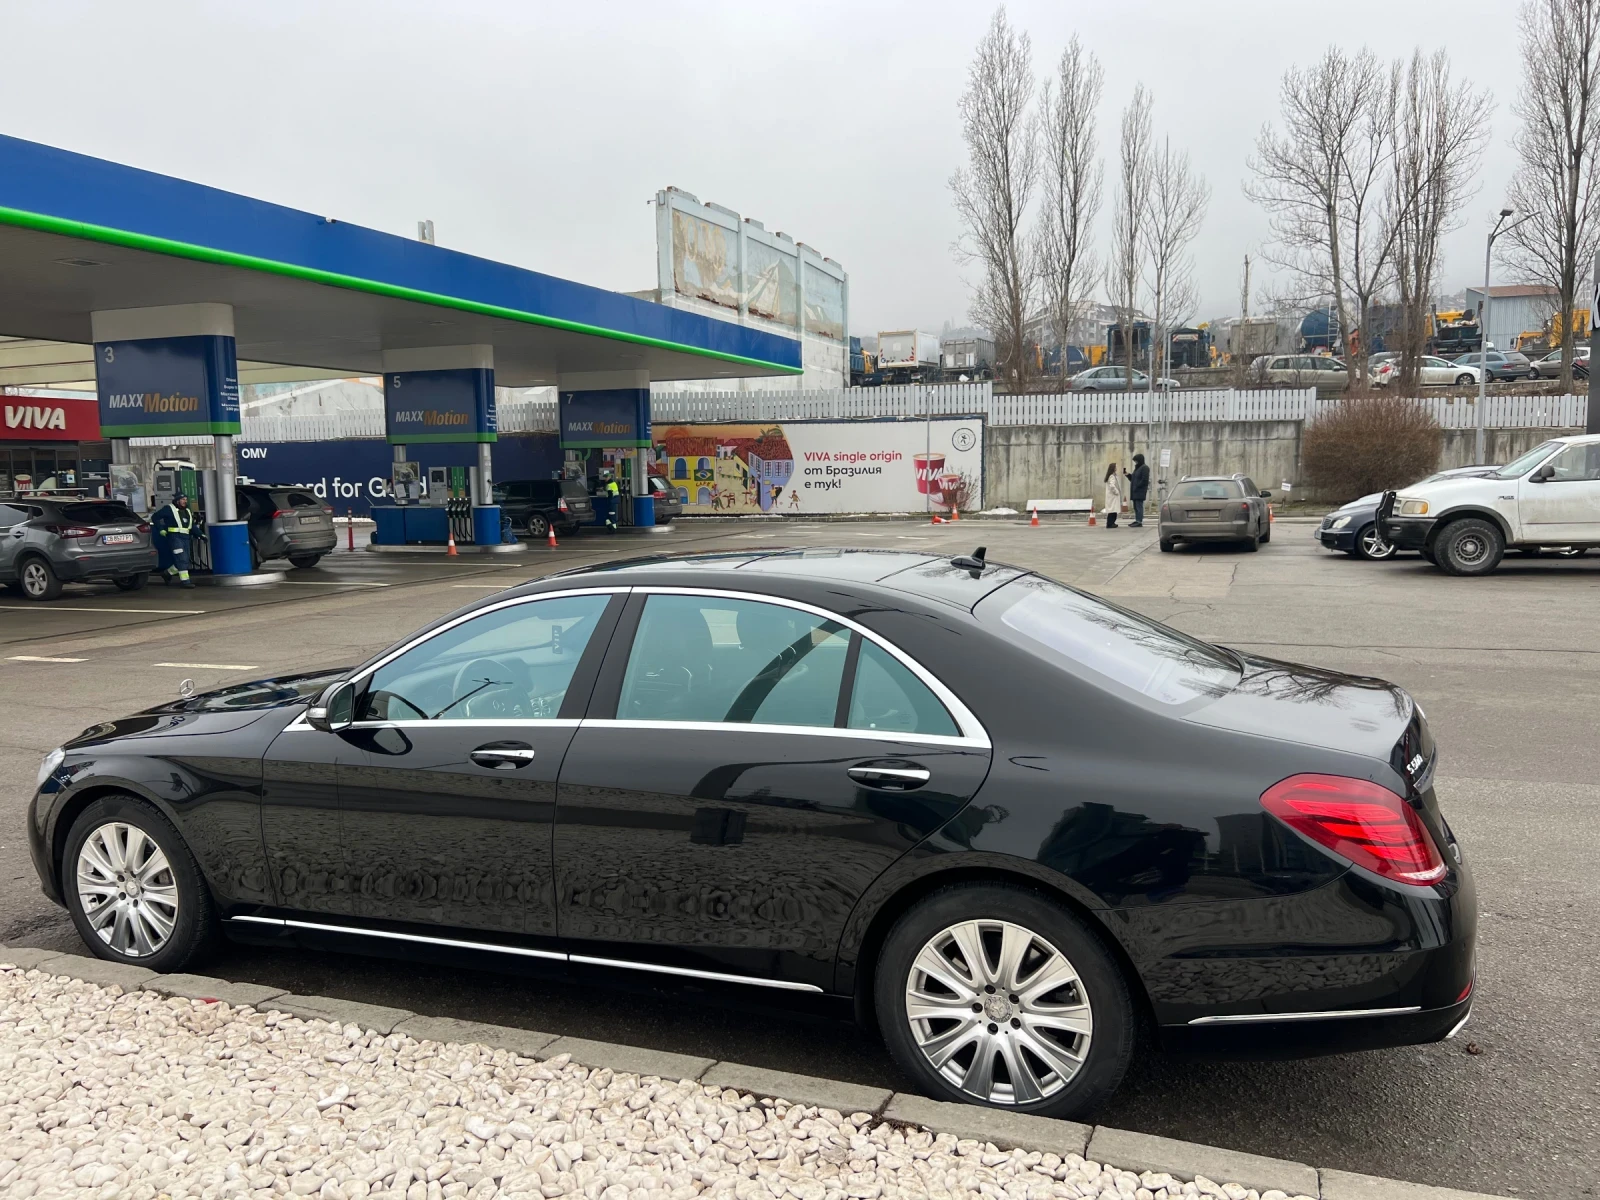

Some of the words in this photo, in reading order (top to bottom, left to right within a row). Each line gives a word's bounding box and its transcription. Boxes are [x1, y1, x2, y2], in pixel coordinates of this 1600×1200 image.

[104, 346, 115, 363] 3
[393, 375, 402, 388] 5
[566, 393, 574, 404] 7
[4, 406, 66, 430] VIVA
[241, 447, 268, 459] OMV
[804, 451, 831, 462] VIVA
[833, 451, 867, 464] single
[869, 450, 903, 463] origin
[804, 467, 823, 475] от
[825, 465, 882, 477] Бразилия
[915, 466, 943, 482] VIVA
[332, 477, 363, 498] for
[368, 475, 428, 498] Gd
[804, 481, 812, 489] е
[814, 478, 842, 491] тук!
